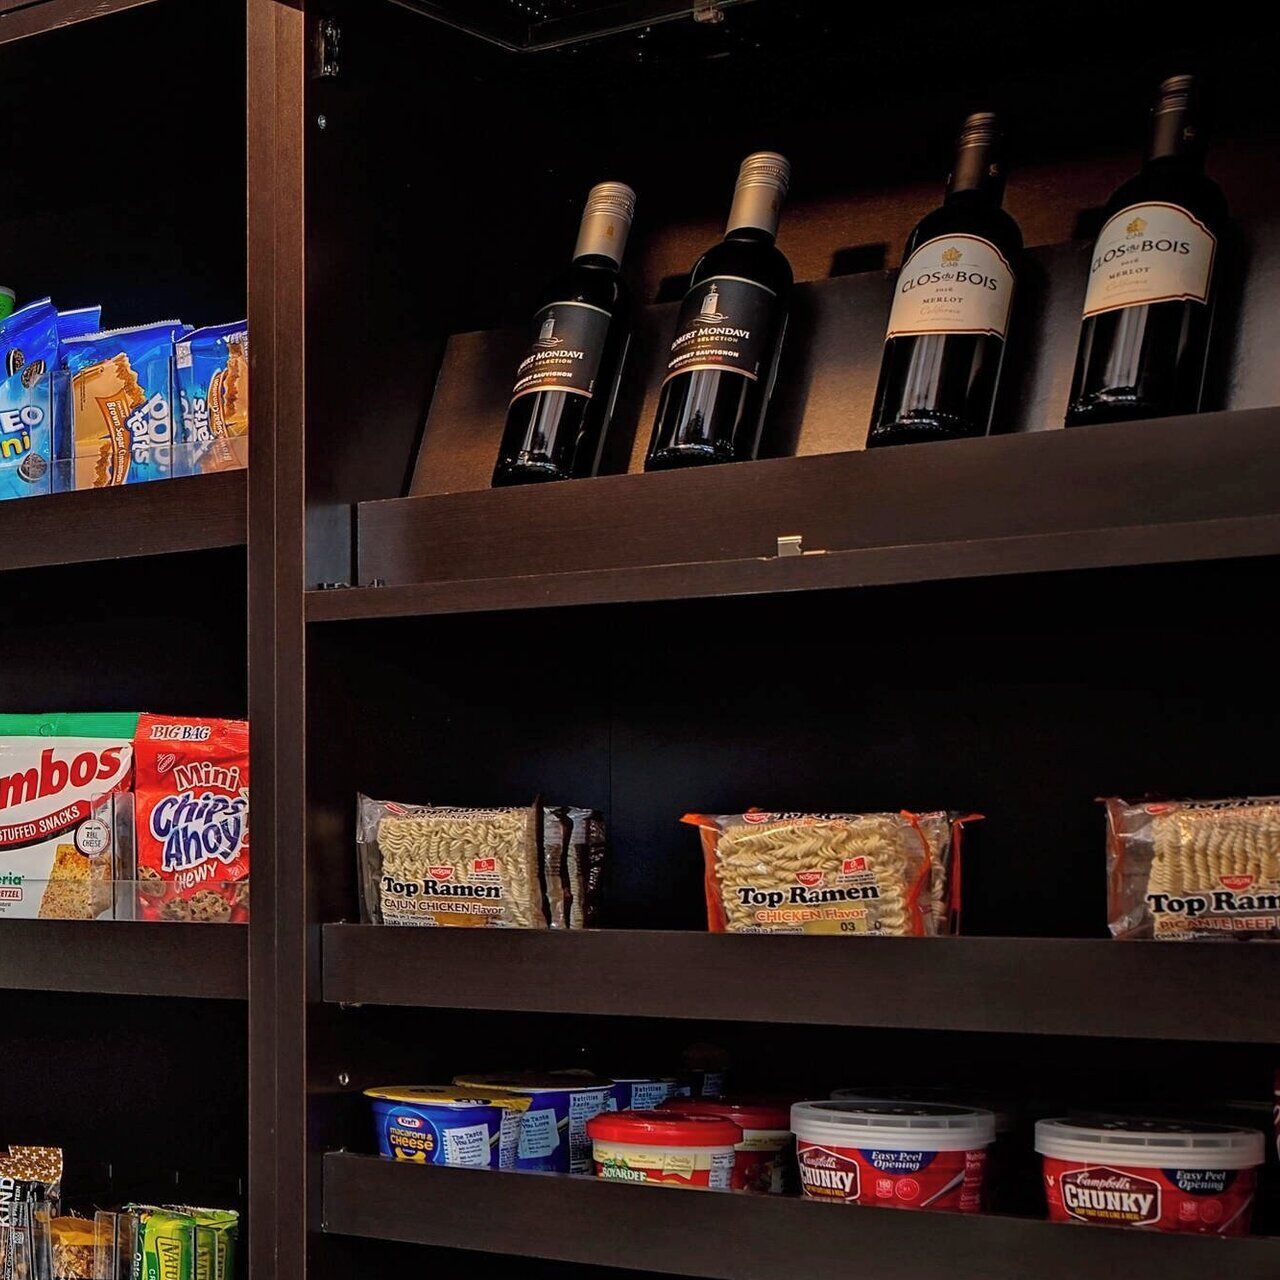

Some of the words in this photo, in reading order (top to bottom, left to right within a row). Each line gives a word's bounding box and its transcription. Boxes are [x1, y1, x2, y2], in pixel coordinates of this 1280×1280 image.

[1091, 244, 1125, 273] CLOS
[1141, 239, 1191, 255] BOIS
[901, 271, 940, 293] CLOS
[955, 270, 998, 291] BOIS
[1108, 267, 1151, 280] MERLOT
[698, 327, 750, 340] MONDAVI
[537, 350, 584, 360] MONDAVI
[695, 348, 740, 359] SAUVIGNON
[151, 725, 181, 741] BIG
[181, 725, 211, 741] BAG
[176, 762, 240, 791] Mini
[39, 805, 81, 833] SNACKS
[153, 790, 248, 841] Chips
[381, 876, 420, 899] Top
[423, 876, 502, 899] Ramen
[738, 886, 788, 908] Top
[791, 883, 879, 904] Ramen
[384, 899, 416, 910] CAJUN
[418, 901, 471, 912] CHICKEN
[472, 903, 504, 915] Flavor
[1146, 893, 1206, 918] Top
[755, 908, 822, 922] CHICKEN
[824, 906, 870, 921] Flavor
[1158, 916, 1231, 932] PICANTE
[1233, 916, 1276, 931] BEEF
[399, 1117, 419, 1127] Kraft
[871, 1150, 893, 1163] Easy
[898, 1150, 923, 1162] Peel
[873, 1159, 921, 1172] Opening
[799, 1165, 855, 1193] CHUNKY
[1176, 1169, 1198, 1183] Easy
[1203, 1169, 1227, 1182] Peel
[1177, 1178, 1225, 1191] Opening
[1064, 1184, 1155, 1216] CHUNKY
